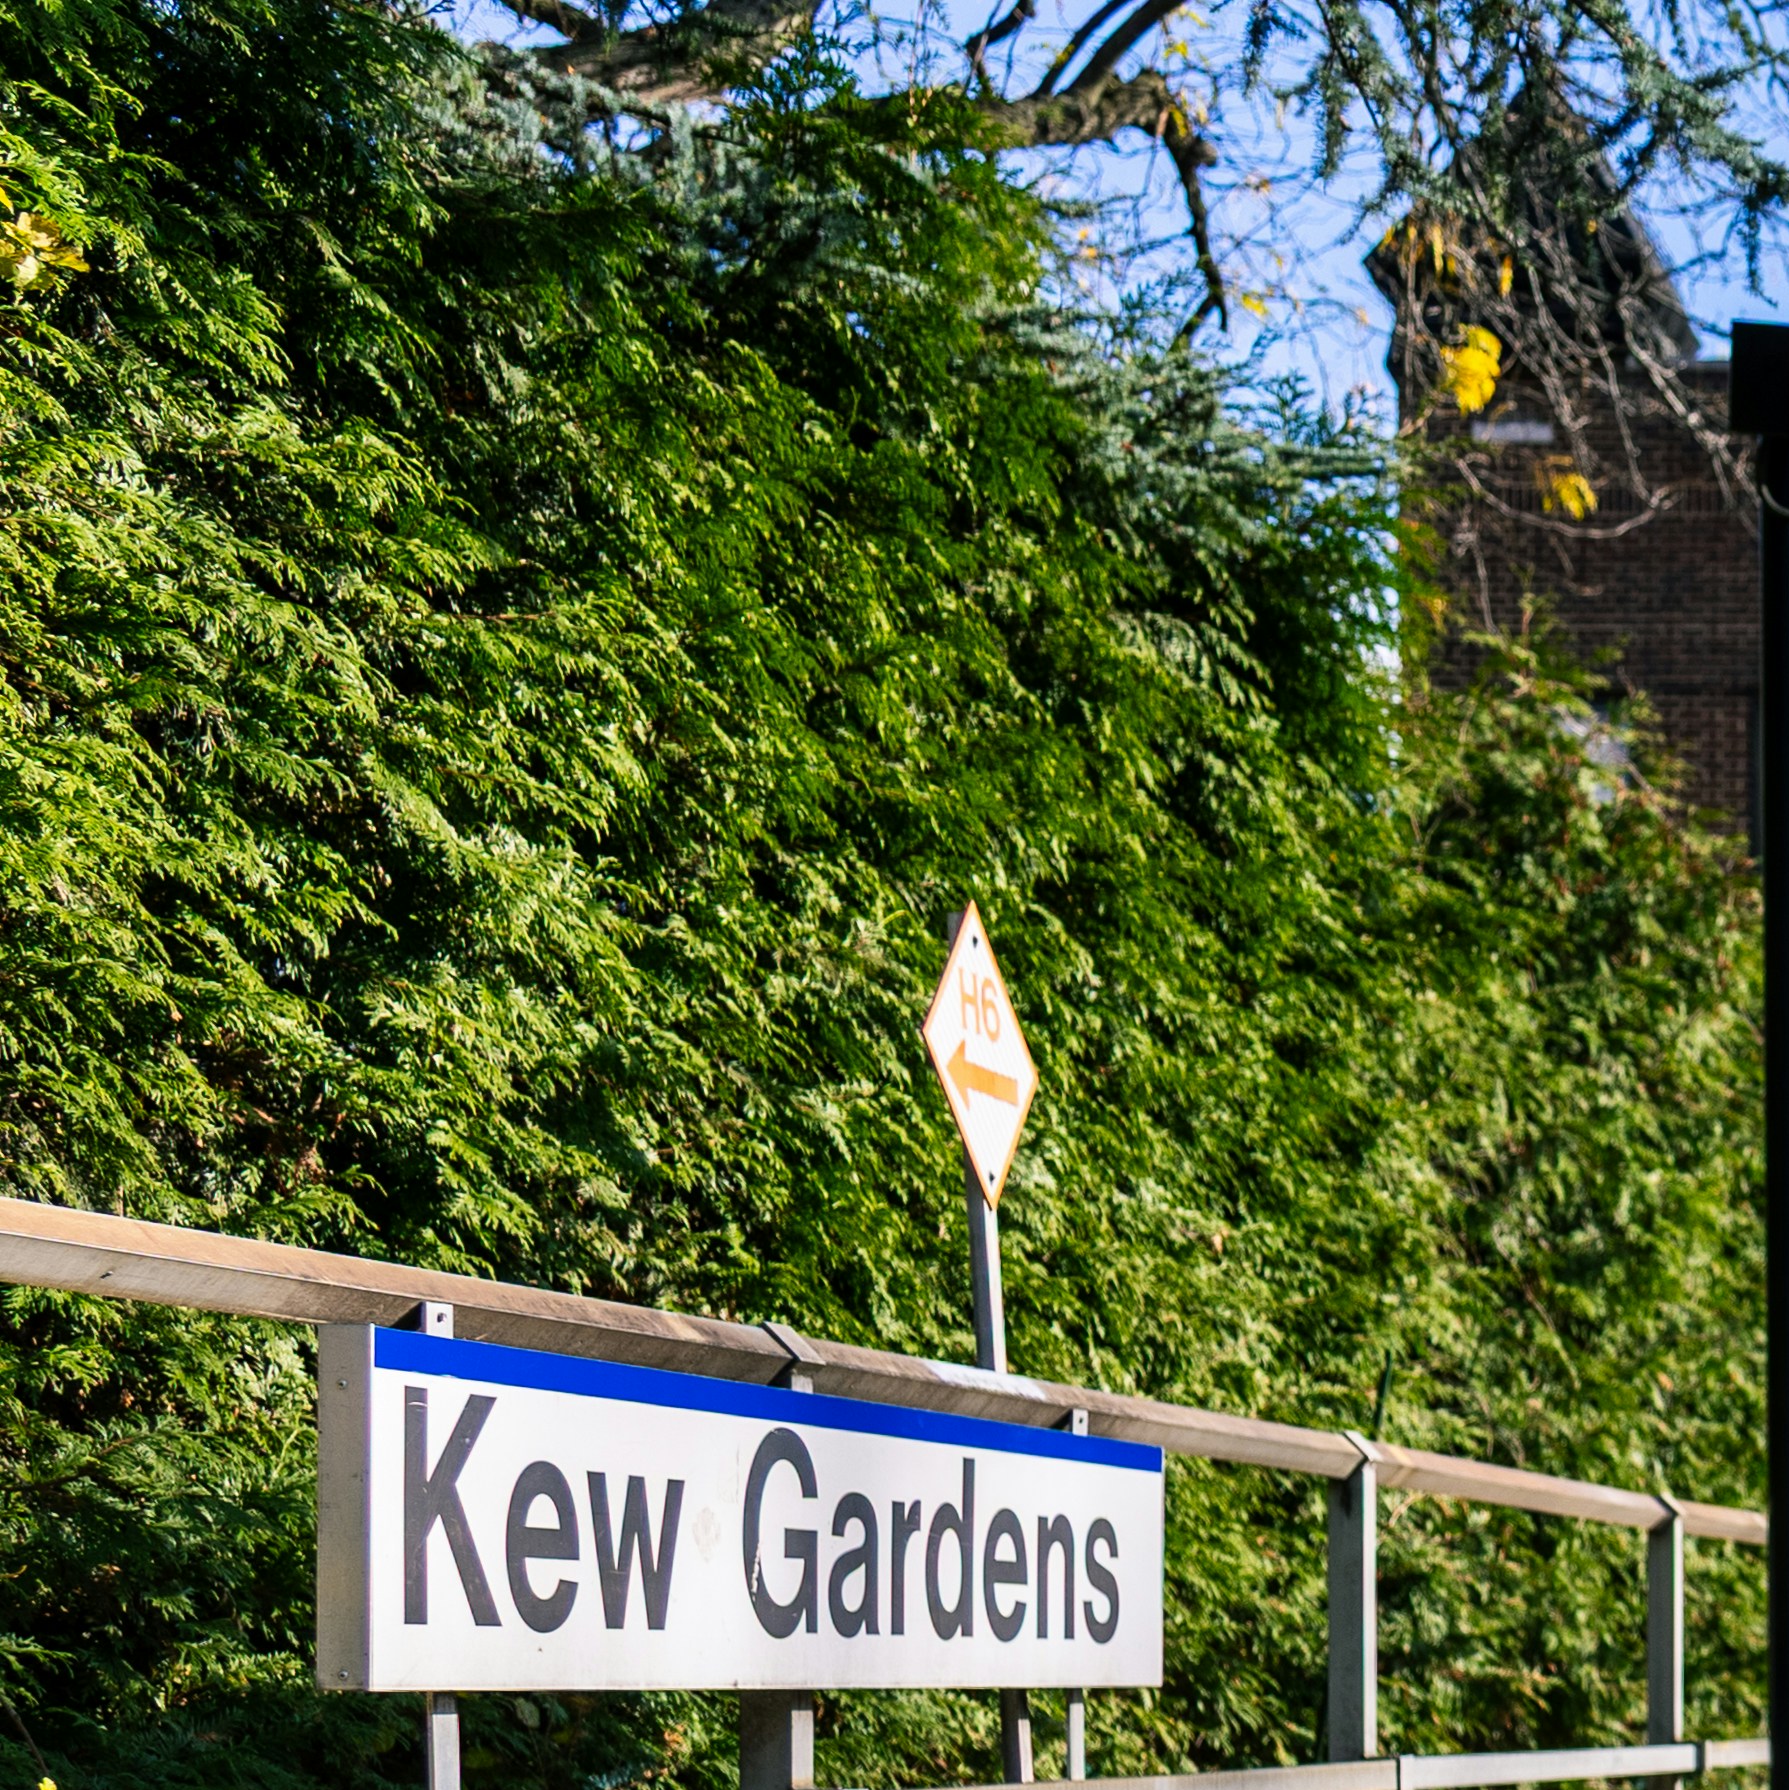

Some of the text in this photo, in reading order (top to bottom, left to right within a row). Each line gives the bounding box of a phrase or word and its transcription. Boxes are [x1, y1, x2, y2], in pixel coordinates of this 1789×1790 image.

[958, 966, 1000, 1043] H6
[403, 1386, 1120, 1644] Kew Gardens
